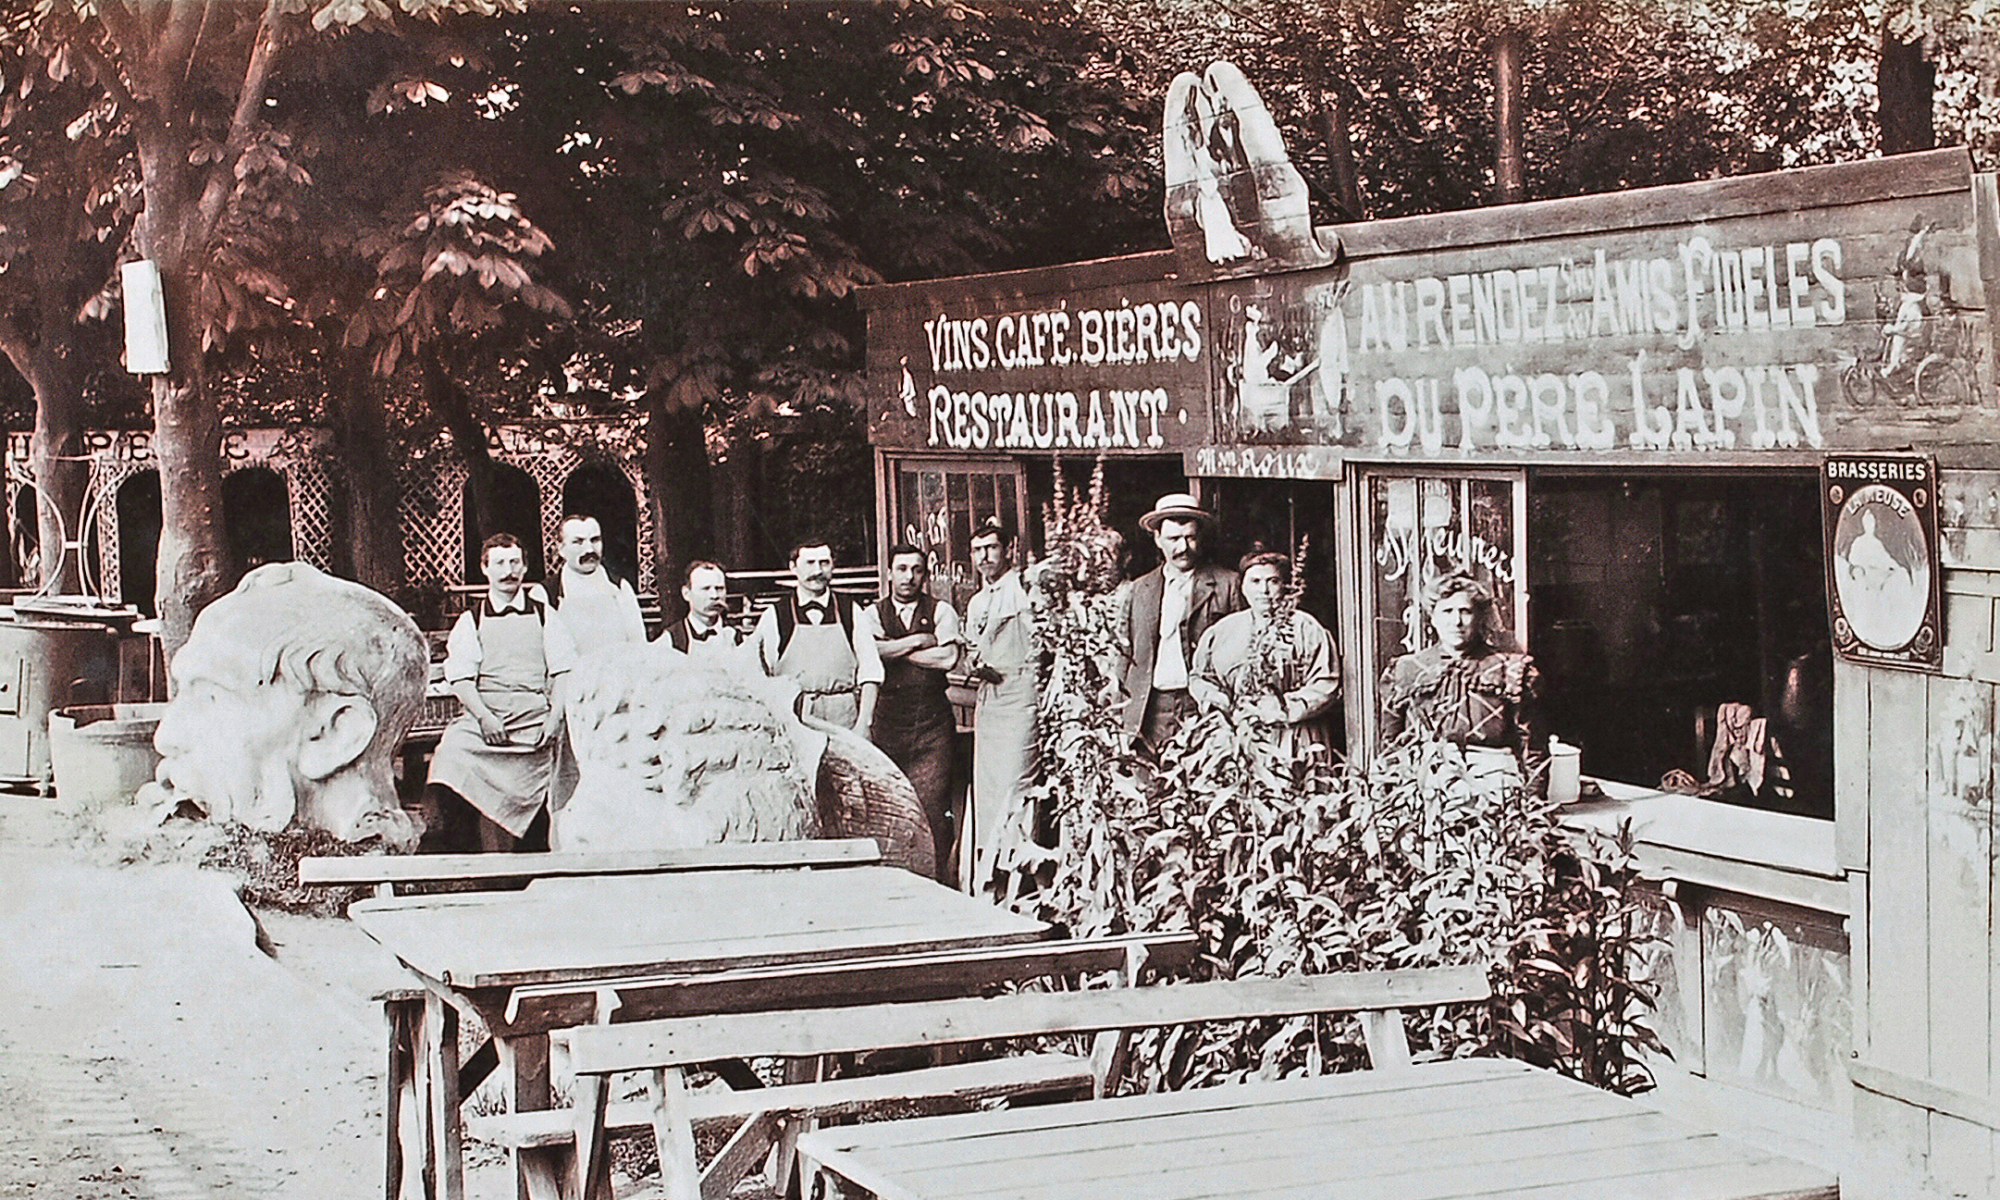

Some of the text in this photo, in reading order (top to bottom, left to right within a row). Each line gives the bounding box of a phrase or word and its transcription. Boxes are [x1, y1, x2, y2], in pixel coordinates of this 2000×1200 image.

[1359, 283, 1408, 353] AU
[1414, 265, 1565, 351] RENDEZ
[1592, 248, 1678, 337] AMIS
[1677, 236, 1847, 350] FIDELES
[927, 384, 1169, 448] RESTAURANT
[1375, 377, 1443, 457] DU
[1628, 348, 1823, 451] LAPIN
[1828, 461, 1926, 481] BRASSERIES
